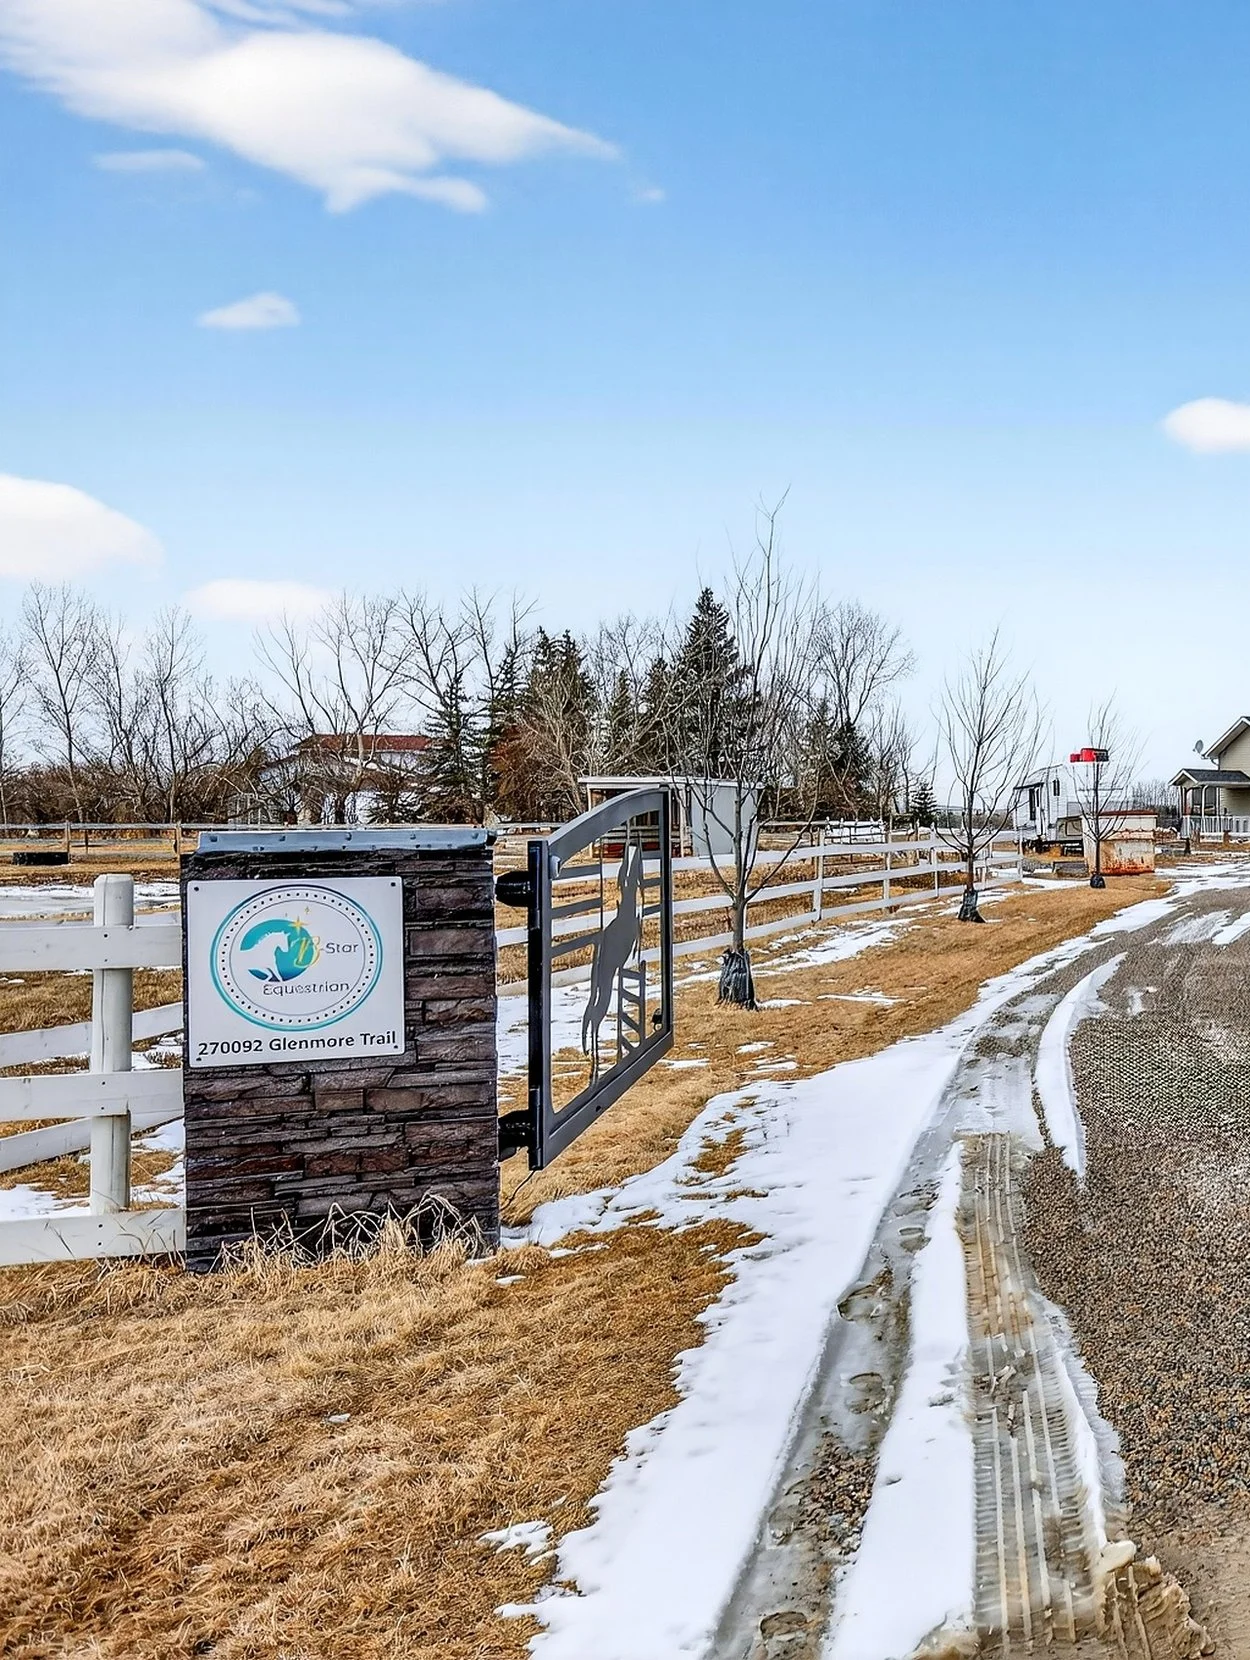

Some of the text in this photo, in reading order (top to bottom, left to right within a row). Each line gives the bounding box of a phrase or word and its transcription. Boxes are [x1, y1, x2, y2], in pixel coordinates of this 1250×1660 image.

[262, 981, 350, 997] Equestrian
[198, 1031, 396, 1056] 270092 Glenmore Trail
